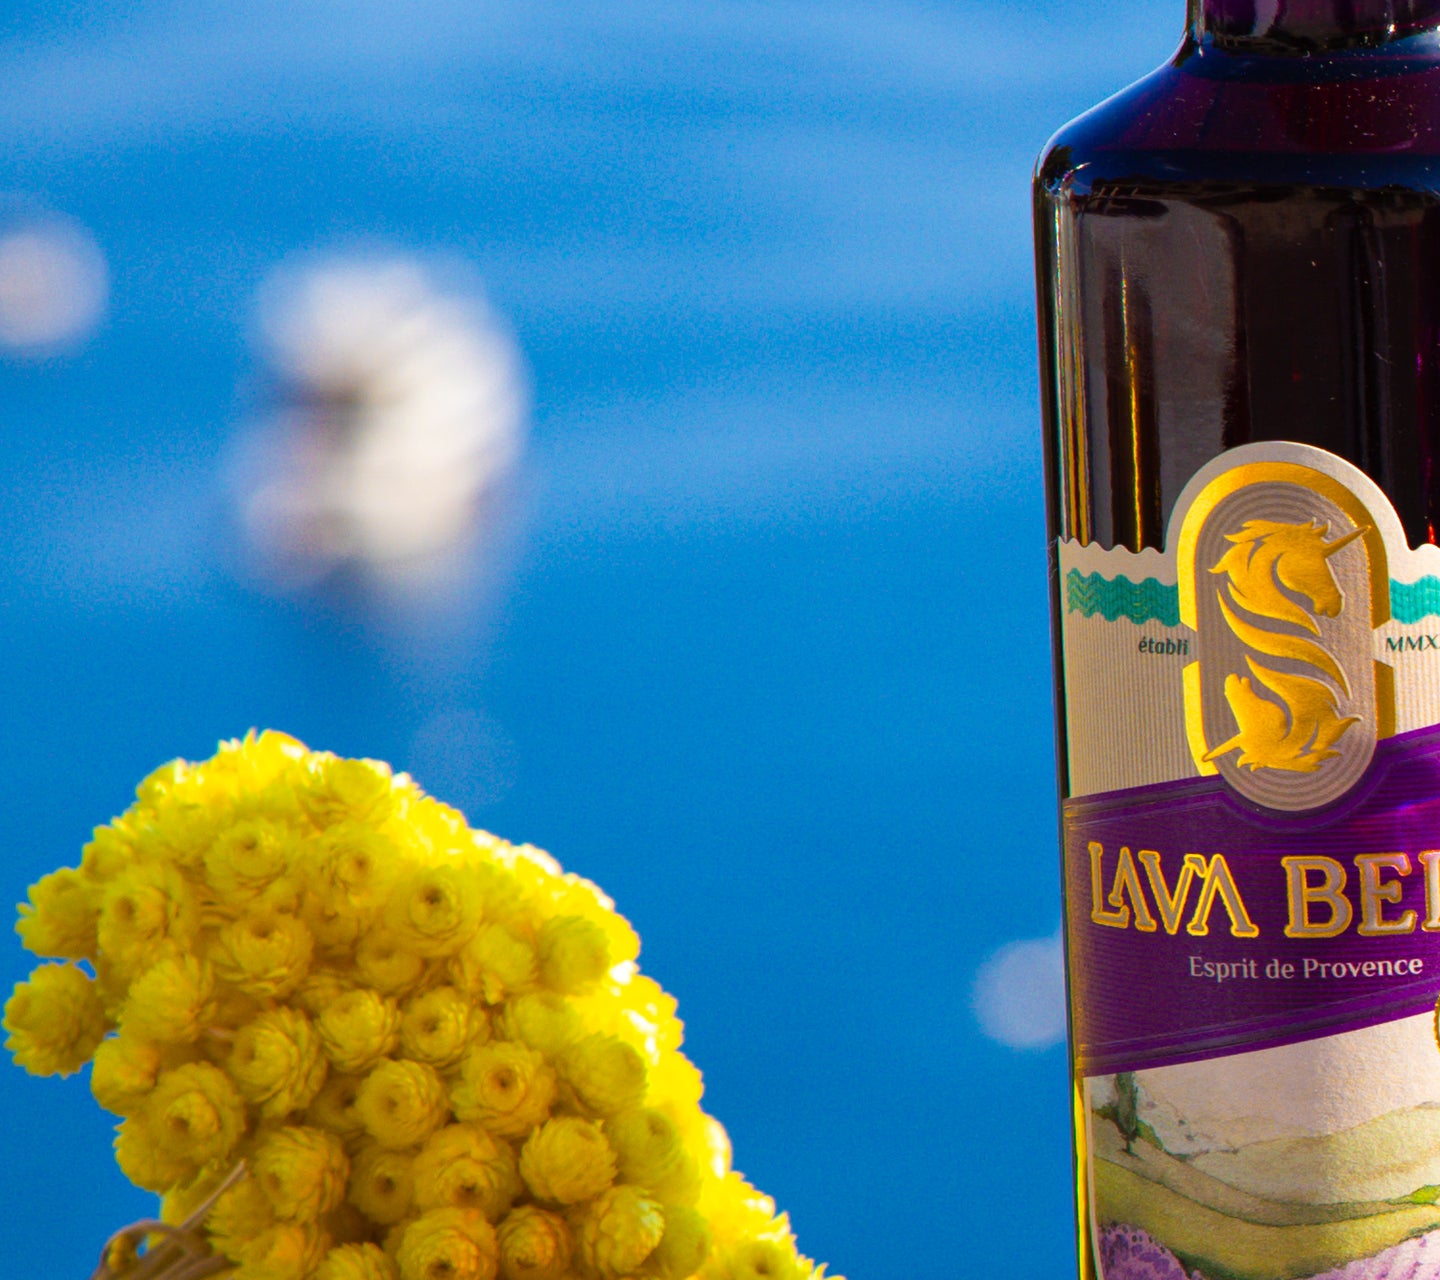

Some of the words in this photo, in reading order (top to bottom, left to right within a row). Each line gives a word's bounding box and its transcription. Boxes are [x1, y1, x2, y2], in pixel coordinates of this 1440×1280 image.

[1138, 635, 1189, 655] établi
[1088, 840, 1259, 938] LAVA
[1189, 956, 1257, 984] Esprit
[1265, 958, 1295, 979] de
[1303, 955, 1424, 978] Provence
